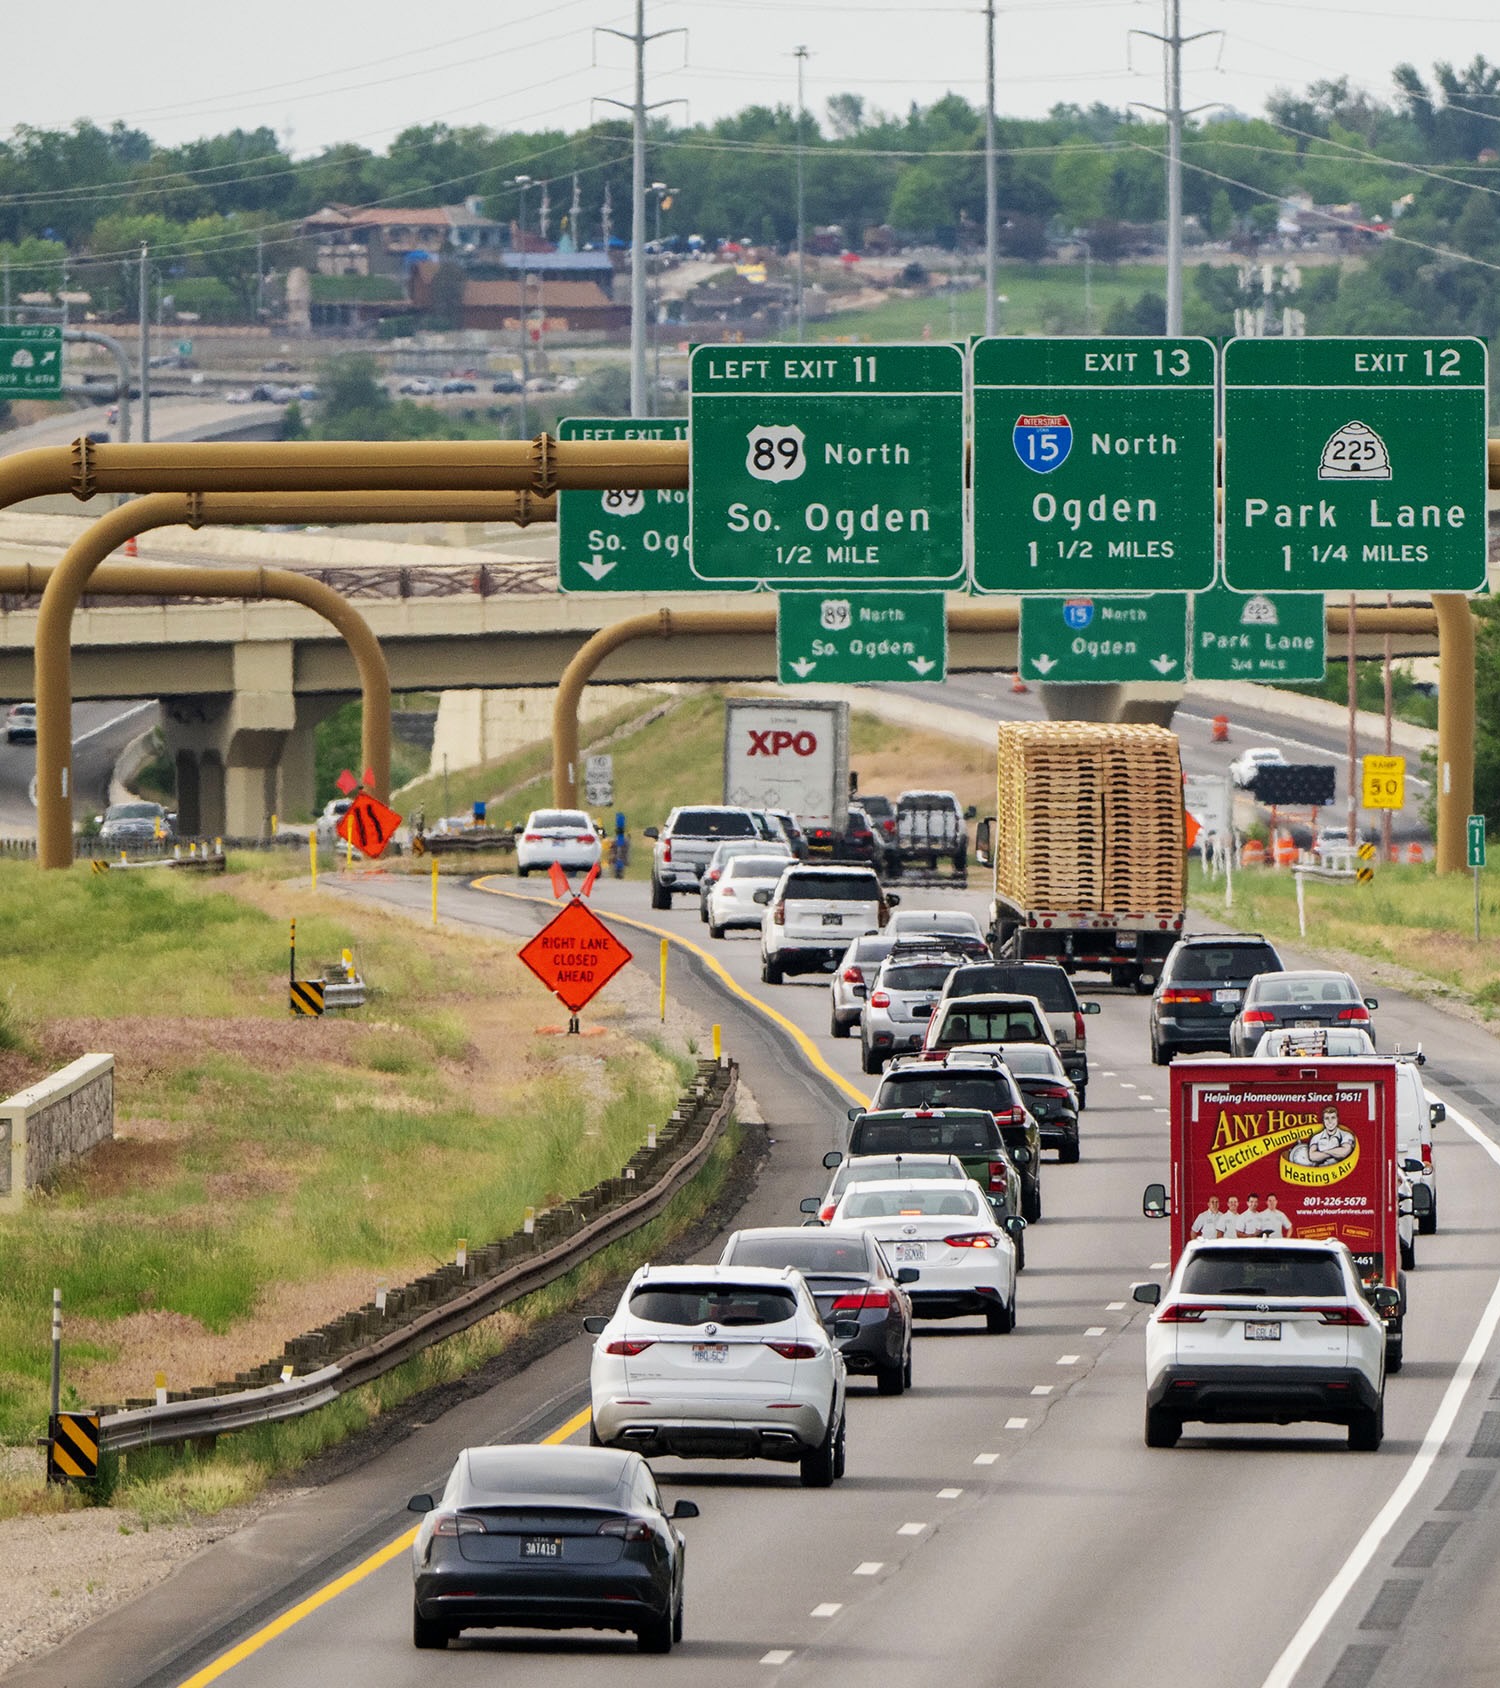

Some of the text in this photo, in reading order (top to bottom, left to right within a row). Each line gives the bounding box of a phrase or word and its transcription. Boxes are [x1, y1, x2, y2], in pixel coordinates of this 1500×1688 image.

[709, 356, 877, 382] LEFT EXIT 11
[1085, 349, 1191, 376] EXIT 13
[1355, 349, 1461, 376] EXIT 12
[1023, 418, 1063, 426] INTERSTATE
[625, 429, 663, 441] EXIT
[753, 438, 910, 470] 89 North
[1028, 433, 1177, 461] 15 North
[1332, 441, 1376, 461] 225
[606, 489, 639, 507] 89
[727, 503, 930, 540] So. Ogden
[1032, 492, 1156, 531] Ogden
[1245, 499, 1465, 528] Park Lane
[588, 530, 626, 550] So.
[776, 546, 879, 564] 1/2 MILE
[1028, 541, 1174, 567] 1 1/2 MILES
[1282, 545, 1428, 572] 1 1/4 MILES
[825, 606, 905, 624] 89 North
[1070, 607, 1147, 623] 15 North
[812, 639, 915, 658] So. Ogden
[1071, 637, 1137, 657] Ogden
[1202, 632, 1315, 650] Park Lane
[747, 730, 817, 757] XPO
[1371, 779, 1397, 795] 50
[542, 937, 609, 950] RIGHT LANE
[553, 954, 597, 966] CLOSED
[557, 970, 594, 982] AHEAD
[1204, 1092, 1362, 1104] Helping Homeowners Since 1961!
[1212, 1110, 1319, 1150] ANY HOUR
[1215, 1128, 1314, 1174] Electric, Plumbing
[1284, 1162, 1352, 1184] Heating & Air
[1303, 1196, 1367, 1207] 801-226-5678
[1352, 1256, 1373, 1265] -461
